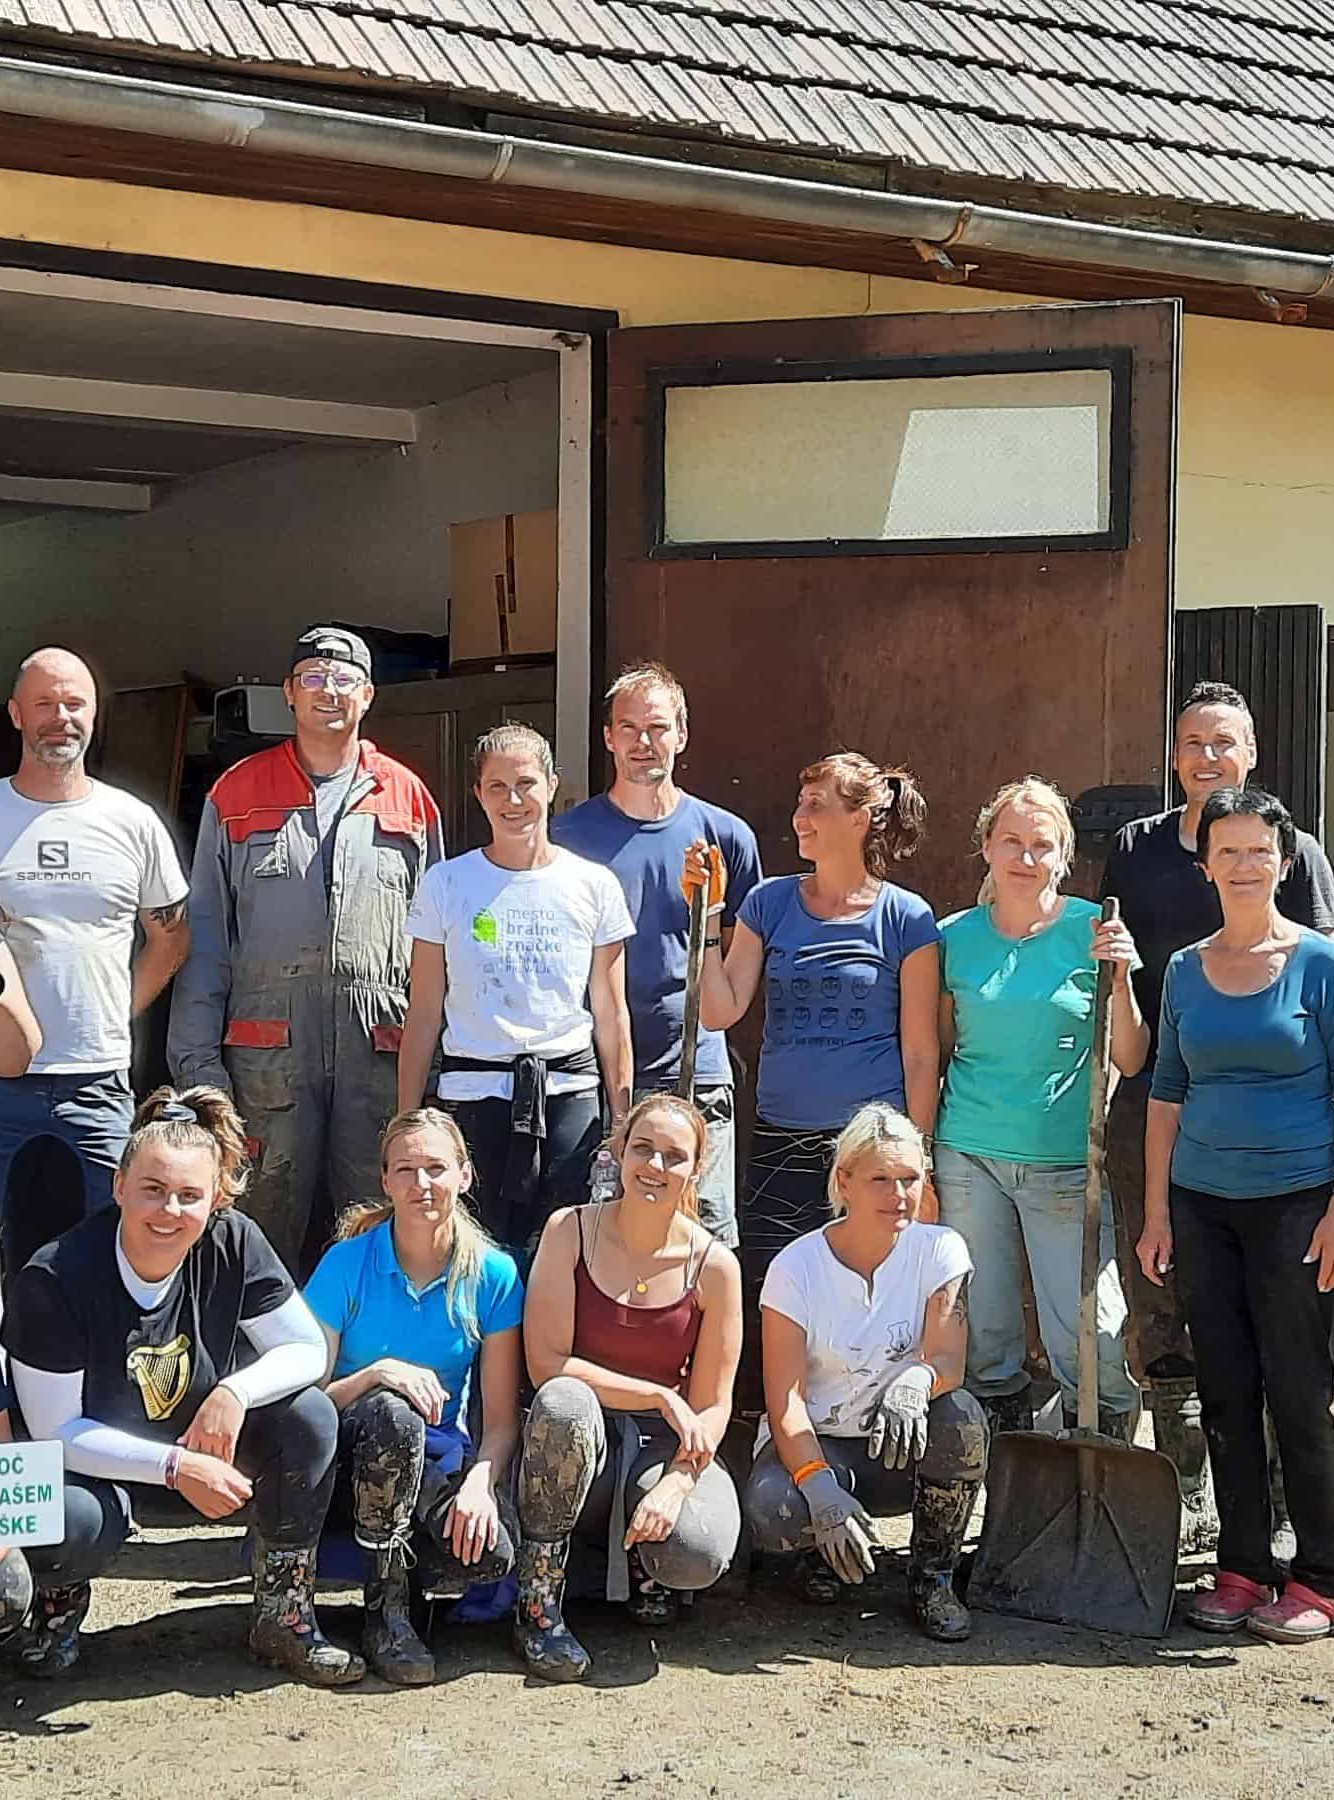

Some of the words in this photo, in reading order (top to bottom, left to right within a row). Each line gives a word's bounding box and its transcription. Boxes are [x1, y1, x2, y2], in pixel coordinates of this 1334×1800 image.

[507, 907, 554, 921] mesto
[507, 922, 559, 936] bralne
[507, 937, 562, 953] značke
